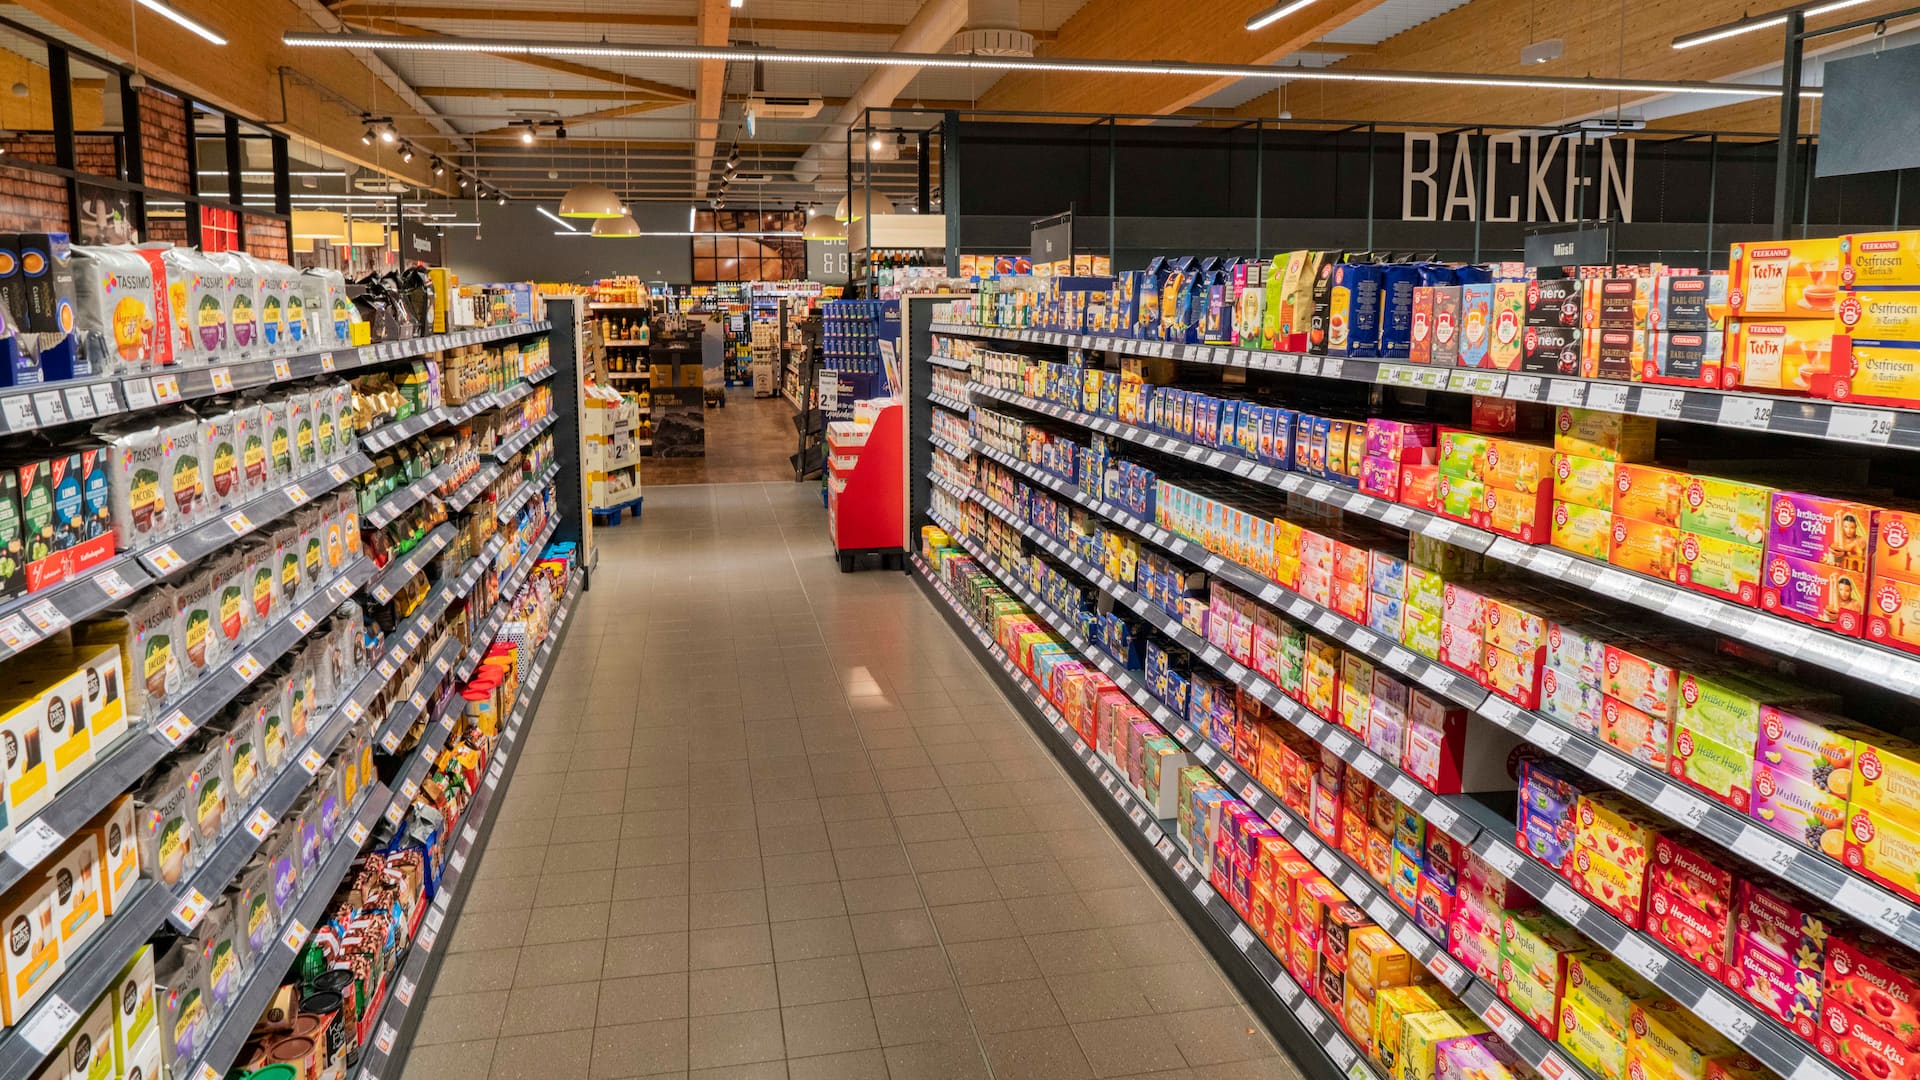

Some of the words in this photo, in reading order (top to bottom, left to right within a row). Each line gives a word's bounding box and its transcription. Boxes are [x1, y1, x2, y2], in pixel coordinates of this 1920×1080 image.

[1402, 131, 1635, 223] BACKEN
[1553, 241, 1575, 257] Müsli
[1753, 249, 1788, 258] TEEKANNE
[1862, 242, 1897, 250] TEEKANNE
[116, 275, 151, 290] TASSIMO
[154, 279, 165, 323] PACK
[1540, 289, 1566, 299] nero
[1868, 301, 1918, 315] Ostfriesen
[1750, 325, 1785, 334] TEEKANNE
[157, 325, 166, 354] BIG
[1538, 336, 1565, 347] nero
[1865, 358, 1914, 373] Ostfriesen
[1753, 408, 1771, 421] 3.29
[1871, 420, 1891, 435] 2.99
[1705, 497, 1737, 513] Sencha
[1797, 508, 1834, 524] Indischer
[1700, 552, 1732, 569] Sencha
[1791, 568, 1830, 585] Indischer
[1726, 701, 1748, 719] Hugo
[1783, 729, 1843, 761] Multivitamin
[1722, 756, 1743, 774] Hugo
[1776, 786, 1836, 821] Multivitamin
[1687, 806, 1704, 821] 2.29
[1771, 853, 1792, 868] 2.29
[1674, 854, 1718, 886] Herzkirsche
[1670, 904, 1713, 939] Herzkirsche
[1748, 901, 1774, 923] Kleine
[1774, 915, 1800, 938] Sünde
[1880, 907, 1905, 926] 2.29
[1514, 931, 1536, 955] Apfel
[1645, 958, 1664, 974] 2.29
[1743, 955, 1768, 979] Kleine
[1769, 971, 1795, 995] Sünde
[1856, 963, 1887, 990] Sweet
[1887, 982, 1910, 1003] Kiss
[1512, 976, 1533, 998] Apfel
[1583, 977, 1612, 1006] Melisse
[1731, 1018, 1752, 1035] 2.29
[1576, 1023, 1605, 1051] Melisse
[1647, 1025, 1679, 1057] Ingwer
[1852, 1024, 1883, 1051] Sweet
[1884, 1044, 1905, 1066] Kiss
